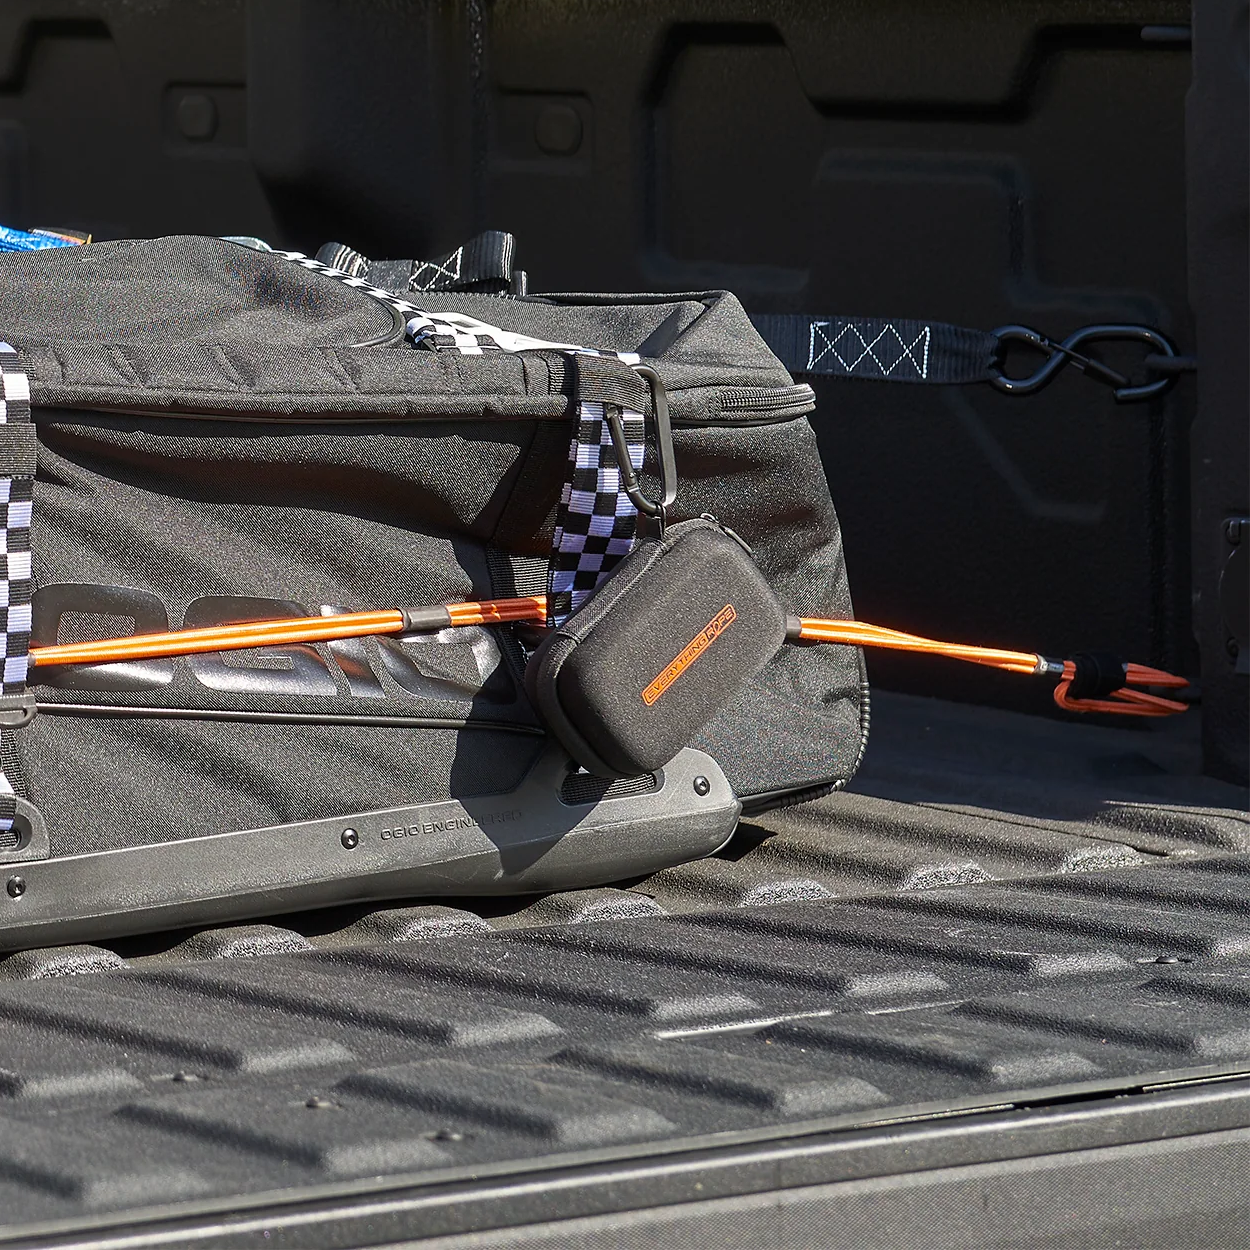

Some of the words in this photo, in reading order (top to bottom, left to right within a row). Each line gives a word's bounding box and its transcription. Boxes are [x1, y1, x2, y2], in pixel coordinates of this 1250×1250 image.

[646, 632, 710, 700] EVERYTHING
[705, 608, 735, 640] ROPE
[380, 823, 420, 841] OGIO
[422, 809, 523, 835] ENGINEERED
